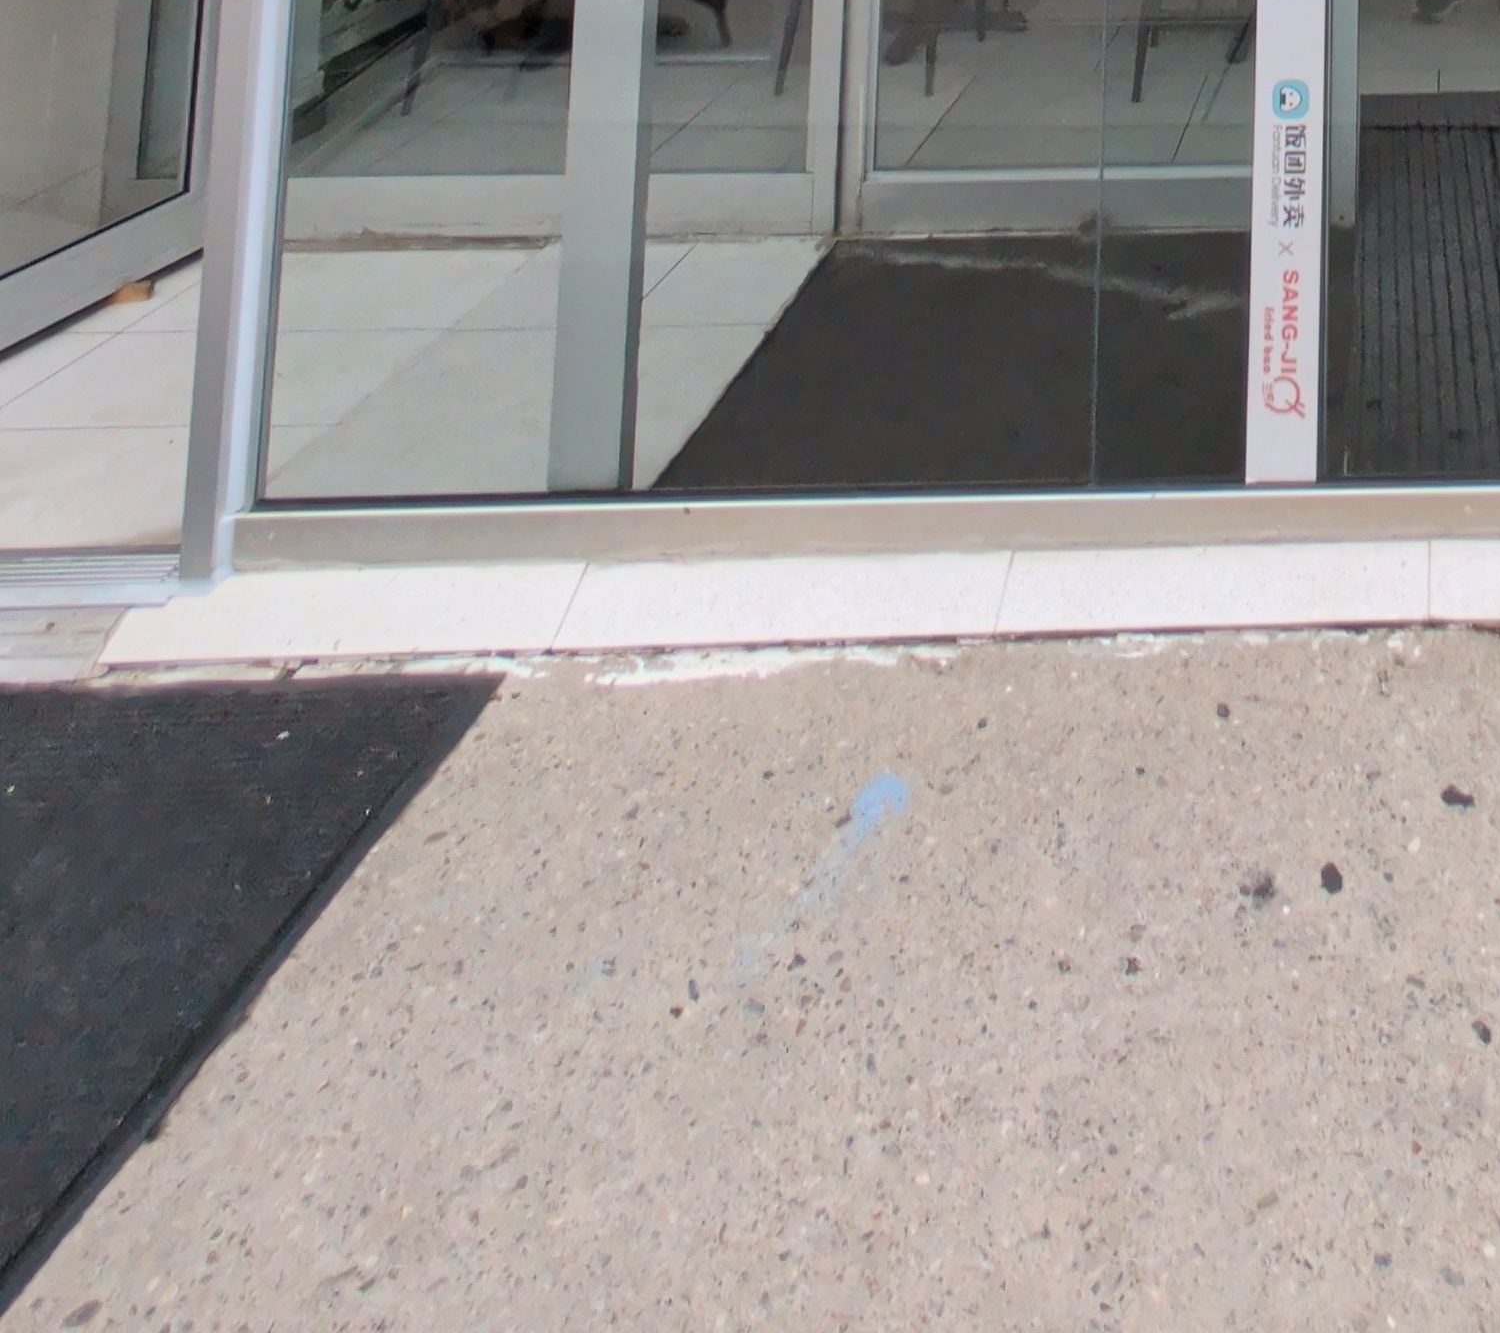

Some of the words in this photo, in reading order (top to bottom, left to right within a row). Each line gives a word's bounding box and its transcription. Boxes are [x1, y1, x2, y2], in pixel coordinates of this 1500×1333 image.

[1272, 125, 1283, 173] Fantuan
[1283, 124, 1307, 228] 饭团外卖
[1268, 176, 1283, 228] Delivery
[1282, 269, 1299, 374] SANG-JI
